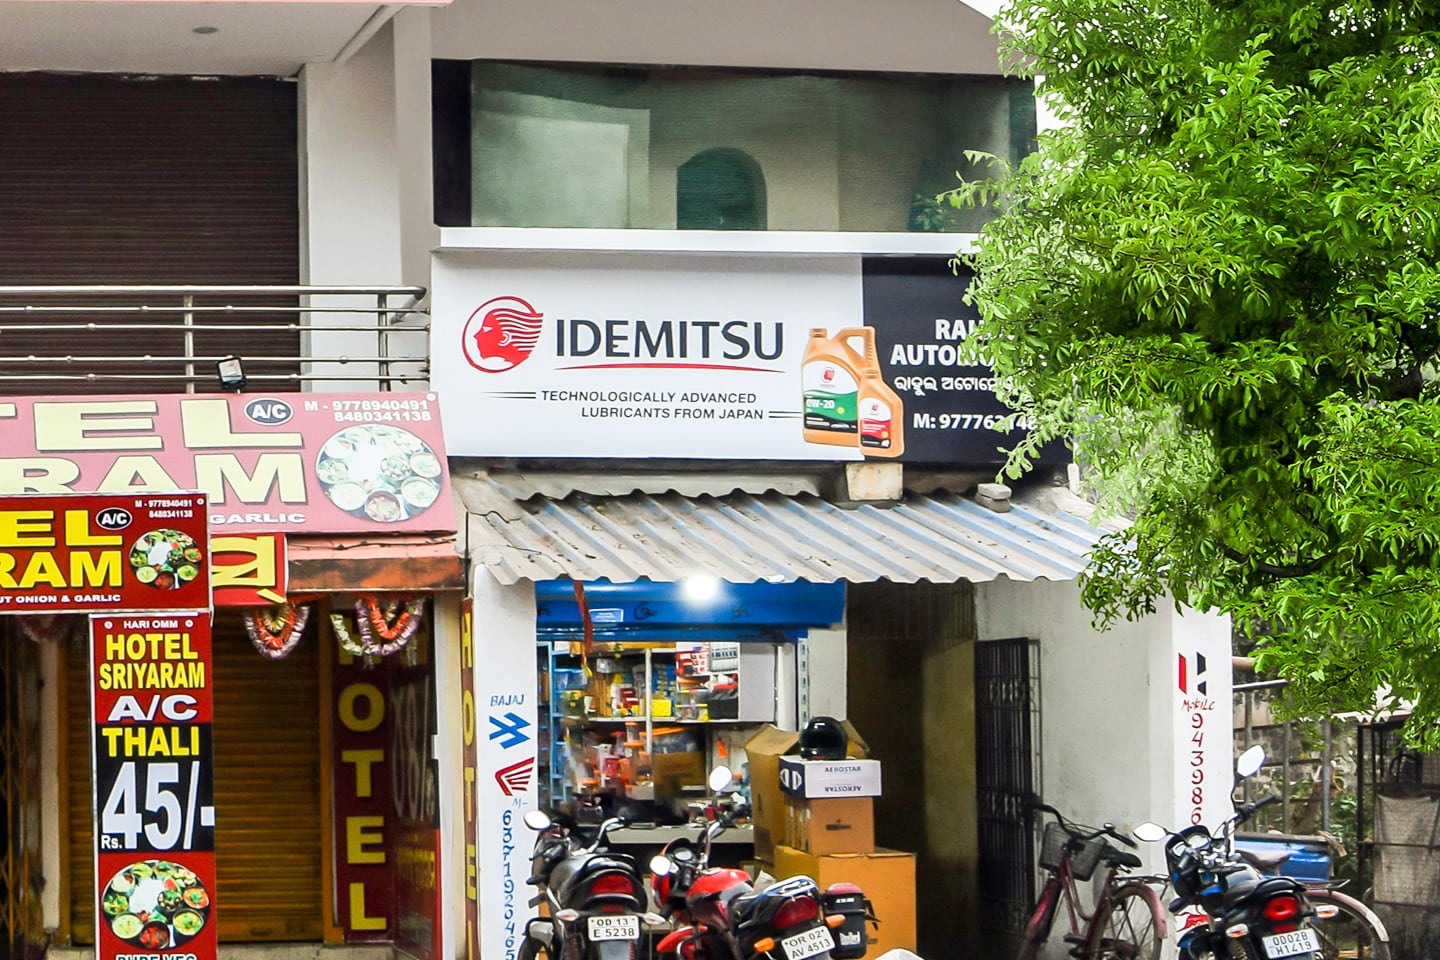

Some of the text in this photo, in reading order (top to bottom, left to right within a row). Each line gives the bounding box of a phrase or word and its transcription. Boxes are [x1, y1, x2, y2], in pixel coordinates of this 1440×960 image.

[556, 319, 784, 361] IDEMITSU
[541, 390, 757, 405] TECHNOLOGICALLY ADVANCED
[251, 404, 288, 420] A/C
[304, 400, 319, 411] M
[332, 399, 429, 412] 9778940491
[334, 410, 432, 422] 8480341138
[581, 406, 765, 421] LUBRICANTS FROM JAPAN
[913, 413, 936, 429] M:
[101, 513, 127, 525] A/C
[211, 513, 306, 524] GARLIC
[16, 594, 58, 604] ONION
[61, 594, 70, 603] &
[74, 594, 121, 603] GARLIC
[123, 620, 178, 629] HARI OMM
[105, 633, 199, 661] HOTEL
[99, 662, 205, 690] SRIYARAM
[107, 694, 198, 722] A/C
[490, 694, 525, 707] BAJAJ
[102, 726, 200, 757] THALI
[101, 760, 215, 850] Rs. 45/-
[596, 919, 612, 927] OD
[593, 927, 635, 938] E 5238
[789, 930, 822, 947] OR 02
[791, 938, 831, 959] AV 4513
